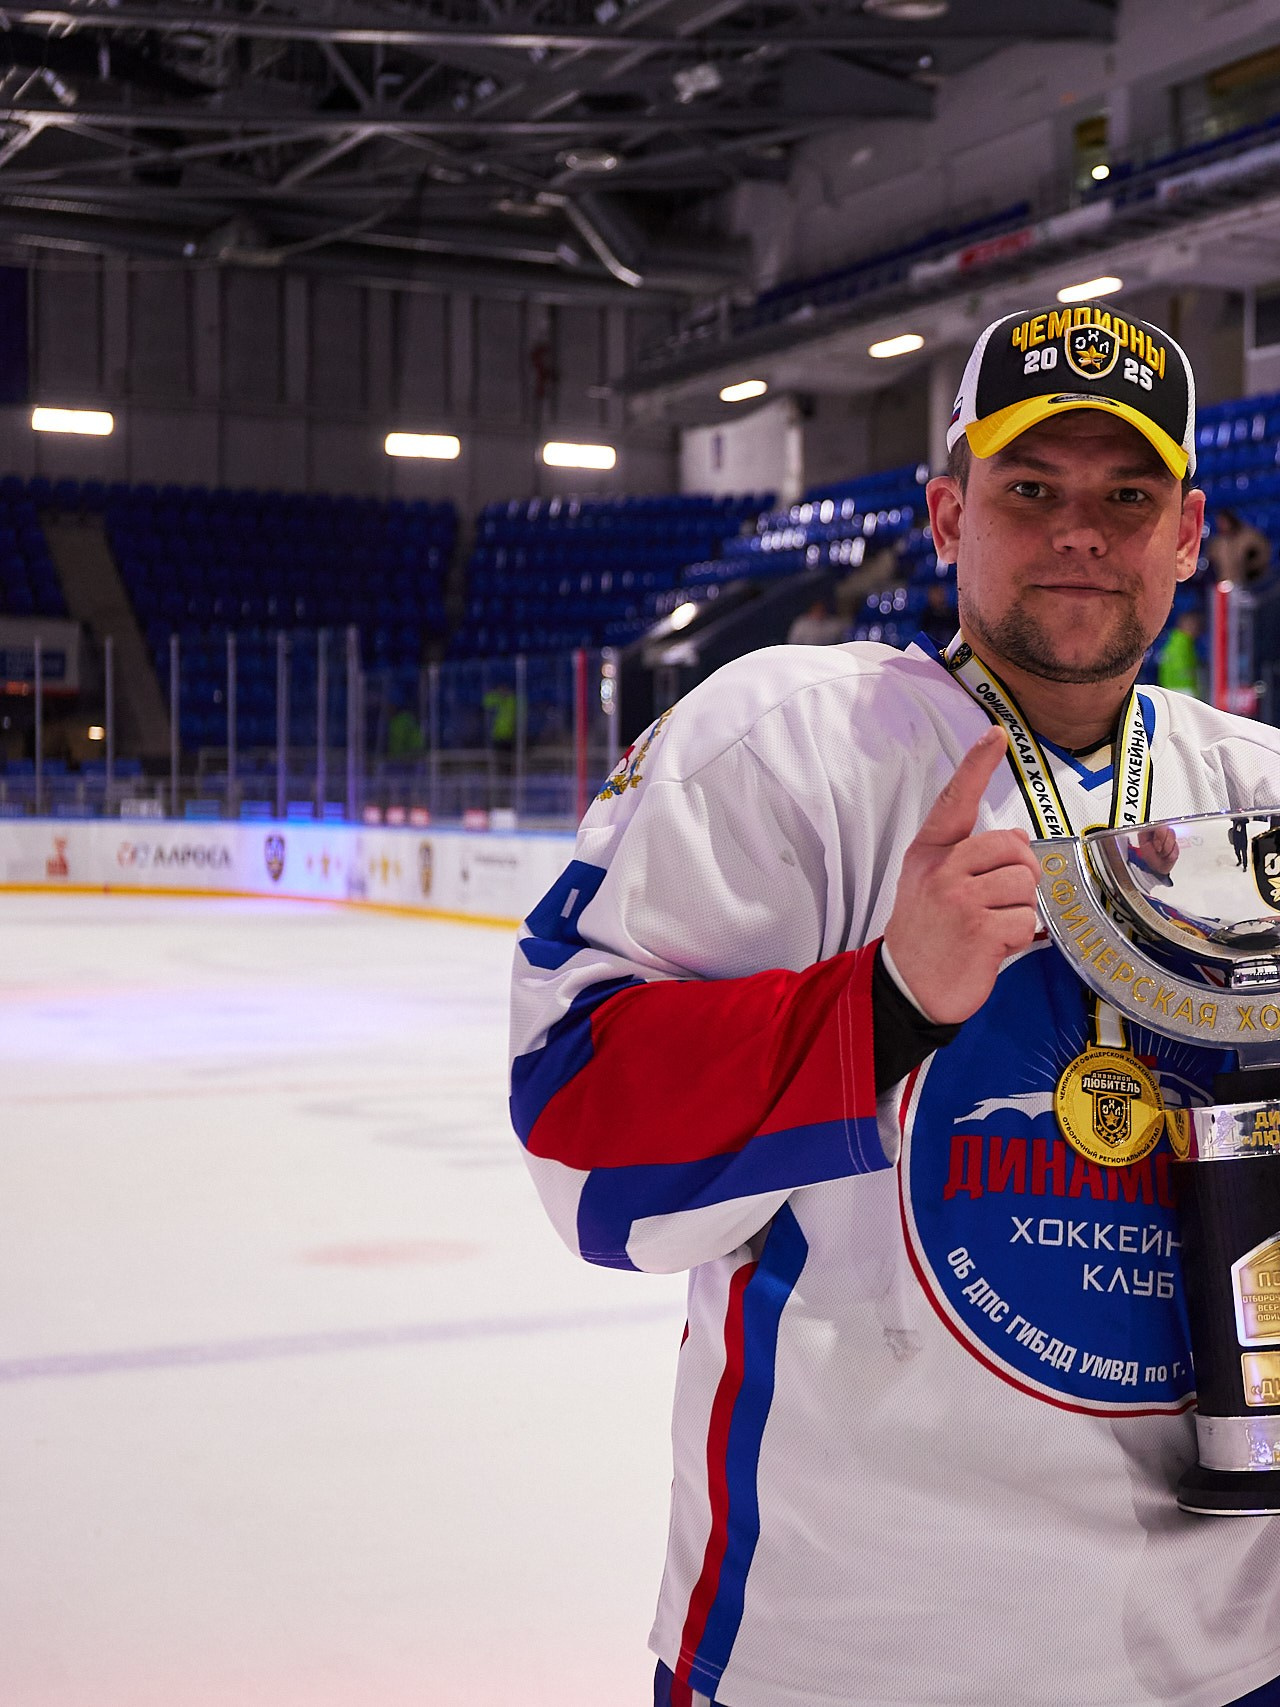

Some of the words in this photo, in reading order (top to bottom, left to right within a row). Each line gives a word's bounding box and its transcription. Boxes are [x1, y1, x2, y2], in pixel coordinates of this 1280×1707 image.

[1012, 307, 1166, 380] ЧЕМПИОНЫ
[1024, 347, 1057, 375] 20
[1124, 358, 1154, 391] 25
[976, 682, 1036, 765] ОФИЦЕРСКАЯ
[1027, 769, 1066, 839] ХОККЕЙ
[1041, 852, 1219, 1030] ОФИЦЕРСКАЯ
[1060, 1061, 1081, 1101] ЧЕМПИОНАТ
[1080, 1051, 1125, 1065] ОФИЦЕРСКОЙ
[1125, 1056, 1159, 1094] ХОККЕЙНОЙ
[1082, 1076, 1141, 1094] ЛЮБИТЕЛЬ
[1062, 1116, 1098, 1159] ОТБОРОЧНЫЙ
[1098, 1144, 1151, 1164] РЕГИОНАЛЬНЫЙ
[1149, 1127, 1160, 1146] ЭТАП
[1009, 1216, 1184, 1257] ХОККЕЙН
[947, 1246, 976, 1280] ОБ
[1082, 1264, 1175, 1299] КЛУБ
[961, 1277, 1011, 1323] ДПС
[1004, 1314, 1078, 1373] ГИБДД
[1078, 1352, 1139, 1386] УМВД
[1145, 1366, 1168, 1382] по
